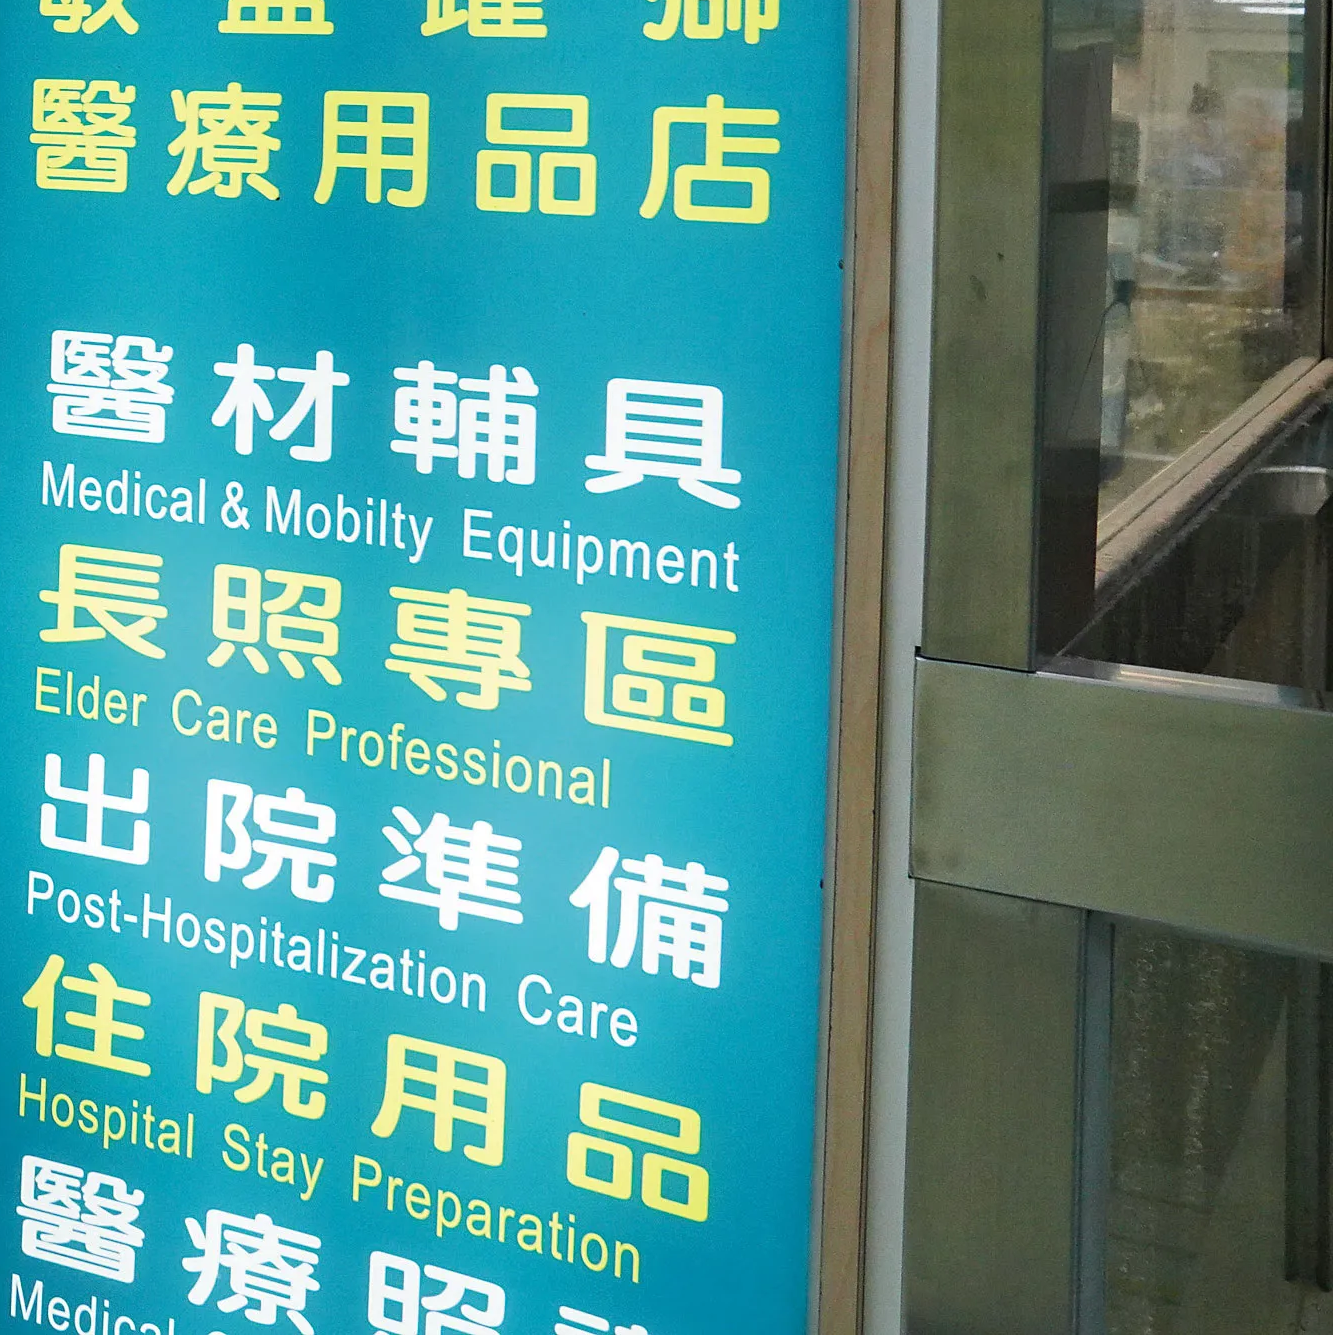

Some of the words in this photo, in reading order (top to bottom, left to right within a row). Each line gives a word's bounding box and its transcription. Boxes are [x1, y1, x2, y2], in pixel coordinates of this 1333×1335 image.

[29, 78, 781, 224] 醫療用品店
[45, 329, 742, 510] 醫材輔具
[41, 461, 208, 527] Medical
[219, 480, 250, 531] &
[264, 484, 434, 565] Mobilty
[462, 508, 741, 594] Equipment
[38, 543, 738, 748] 長照專區
[34, 667, 148, 728] Elder
[171, 687, 278, 750] Care
[305, 709, 612, 809] Professional
[26, 872, 488, 1013] Post-Hospitalization
[517, 974, 640, 1049] Care
[39, 752, 730, 990] 出院準備
[21, 953, 711, 1224] 住院用品
[16, 1154, 648, 1335] 醫療照
[18, 1074, 195, 1163] Hospital
[222, 1126, 325, 1205] Stay
[351, 1155, 642, 1285] Preparation
